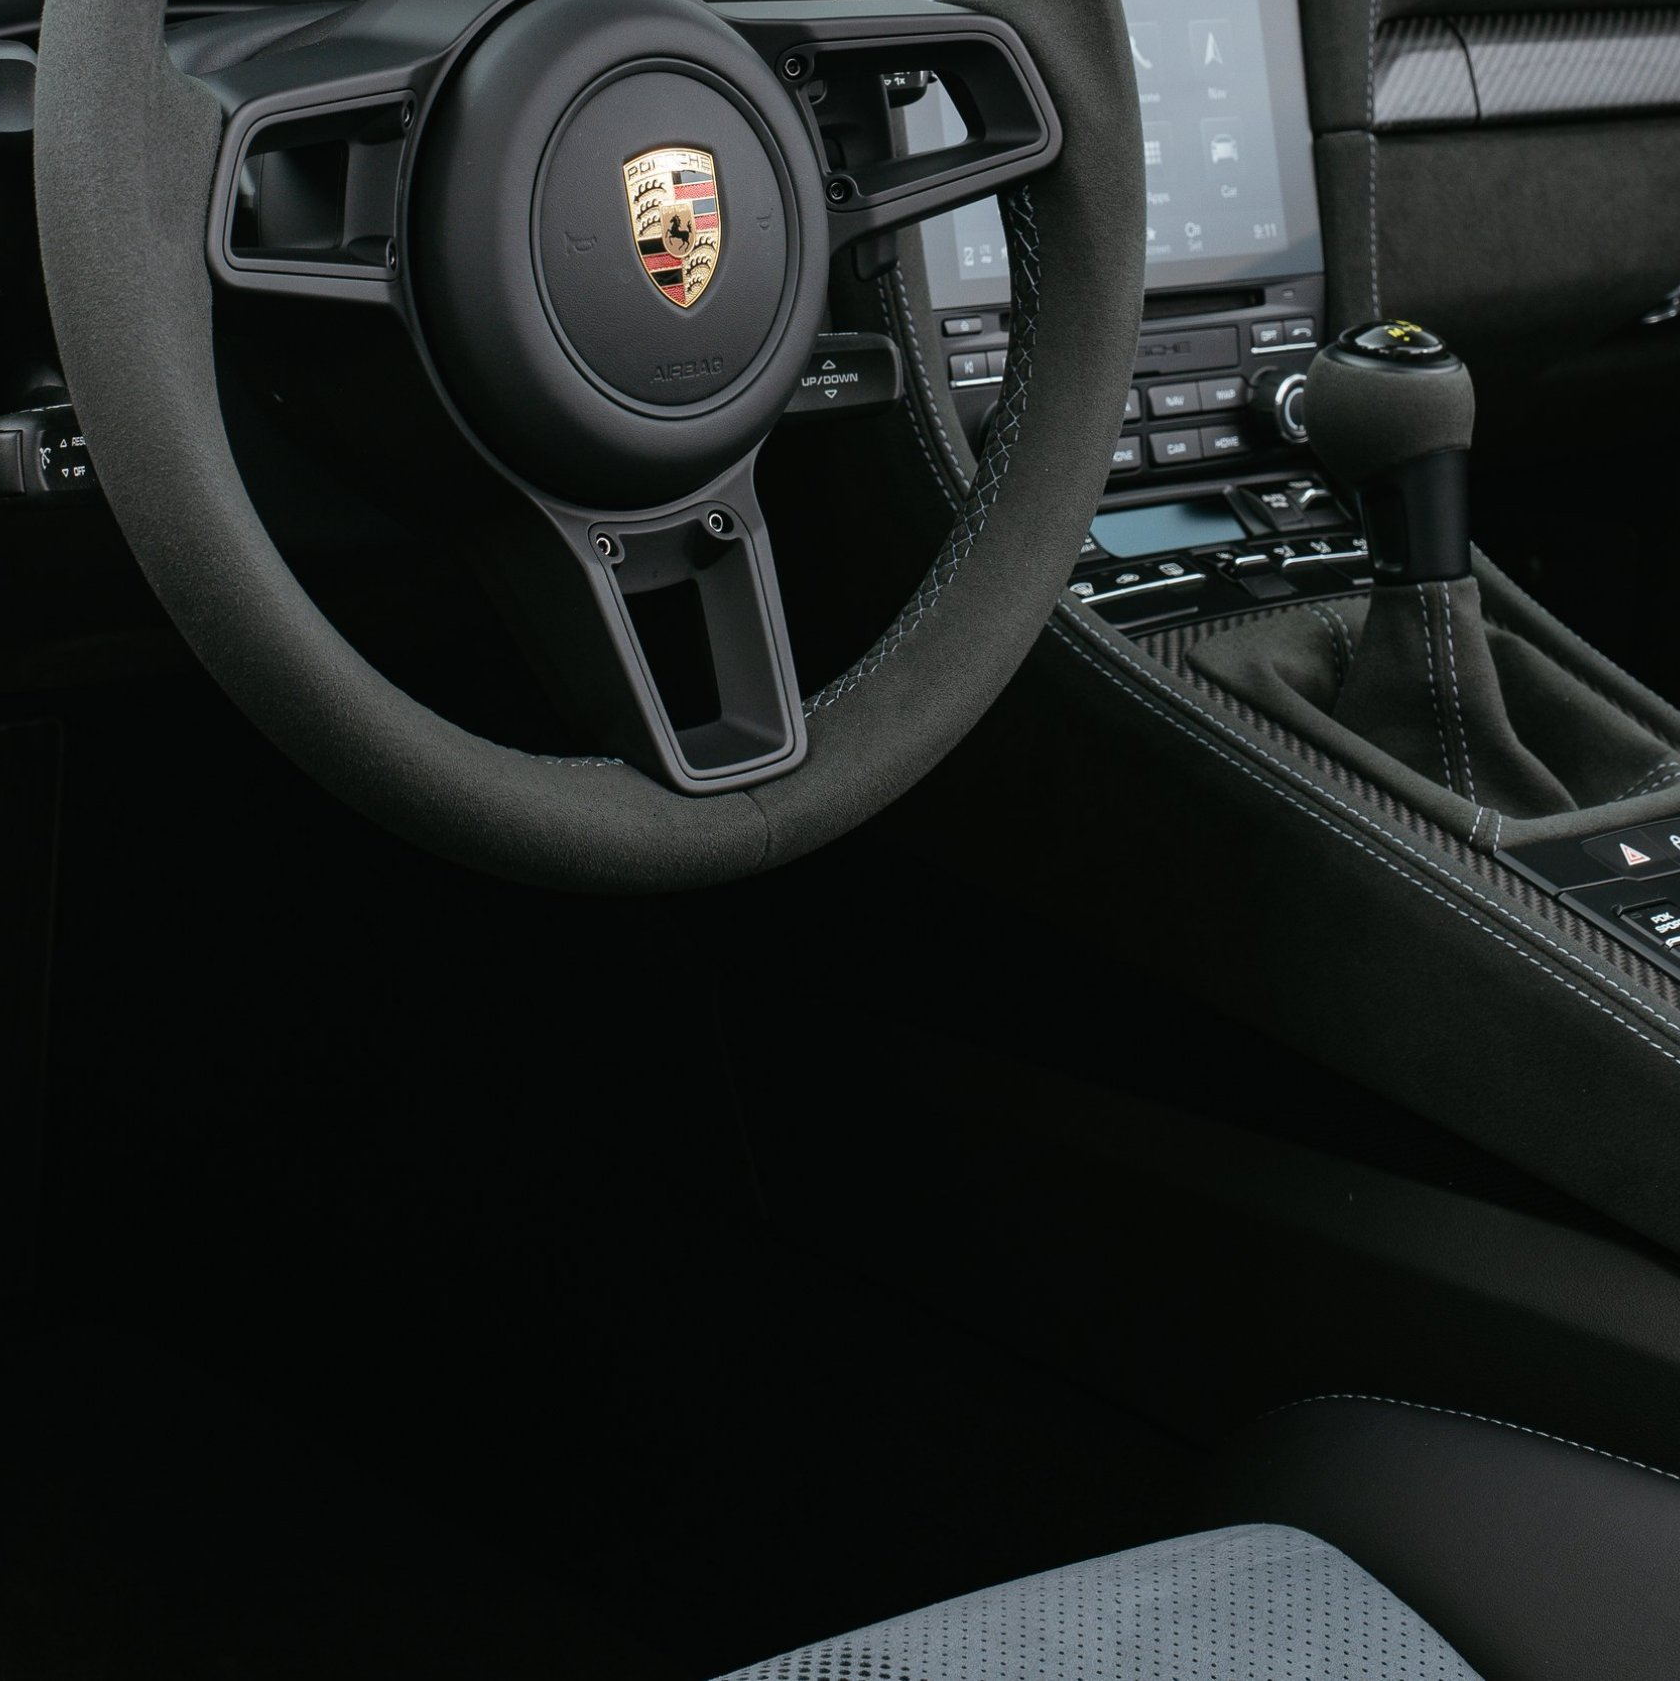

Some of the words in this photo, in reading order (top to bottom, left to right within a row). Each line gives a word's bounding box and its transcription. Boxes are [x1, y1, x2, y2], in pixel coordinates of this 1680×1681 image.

[649, 356, 724, 384] AIRBAG
[801, 373, 859, 387] UP/DOWN
[1167, 442, 1187, 455] CAR
[1112, 449, 1134, 462] ONE
[73, 465, 86, 477] OFF
[1650, 911, 1675, 924] PDK
